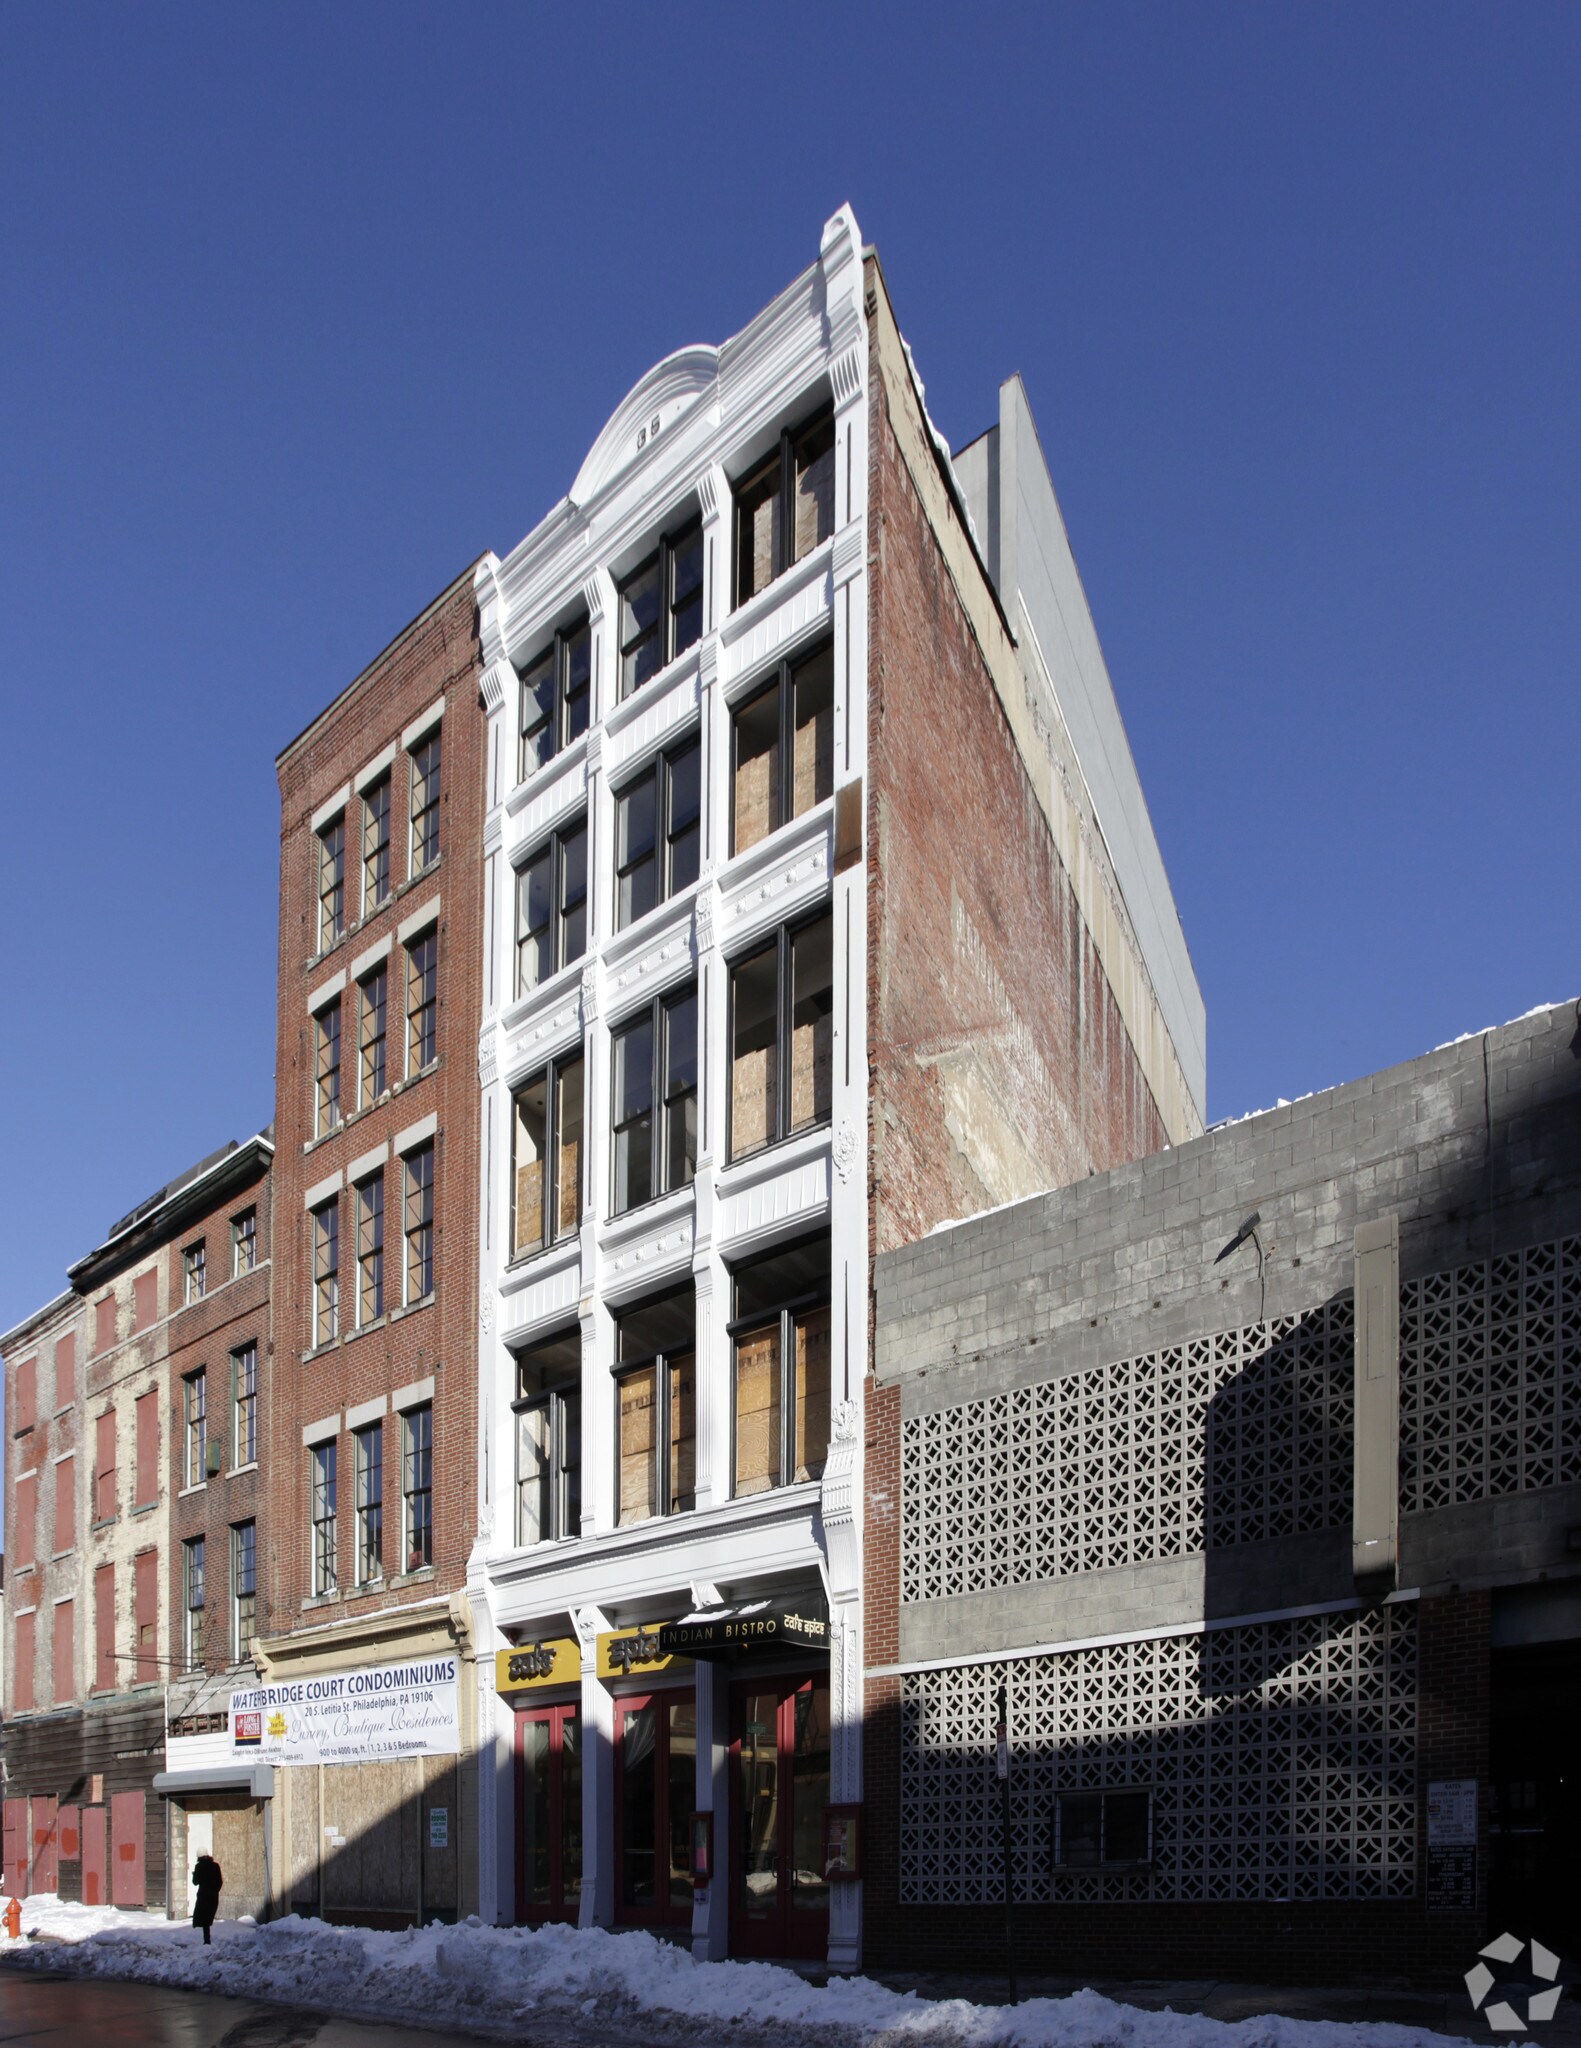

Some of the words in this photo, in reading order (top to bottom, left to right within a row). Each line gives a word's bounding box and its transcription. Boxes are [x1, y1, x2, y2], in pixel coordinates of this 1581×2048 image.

[663, 1627, 713, 1643] INDIAN
[725, 1620, 777, 1638] BISTRO
[784, 1614, 803, 1632] cafe
[804, 1618, 825, 1638] spice
[509, 1643, 557, 1677] cafe
[609, 1627, 661, 1672] spic
[232, 1684, 304, 1710] WATERBRIDGE
[306, 1678, 345, 1700] COURT
[348, 1661, 455, 1694] CONDOMINIUMS
[305, 1707, 313, 1717] 20
[313, 1705, 320, 1716] S.
[321, 1703, 342, 1716] Letitia
[343, 1702, 352, 1712] St.
[353, 1696, 399, 1711] Philadelphia,
[400, 1693, 410, 1705] PA
[411, 1690, 434, 1704] 19106
[333, 1713, 385, 1742] Boutique
[388, 1706, 454, 1731] Residences
[319, 1748, 331, 1757] 900
[331, 1747, 337, 1756] to
[338, 1745, 351, 1755] 4000
[398, 1739, 427, 1750] Bedrooms
